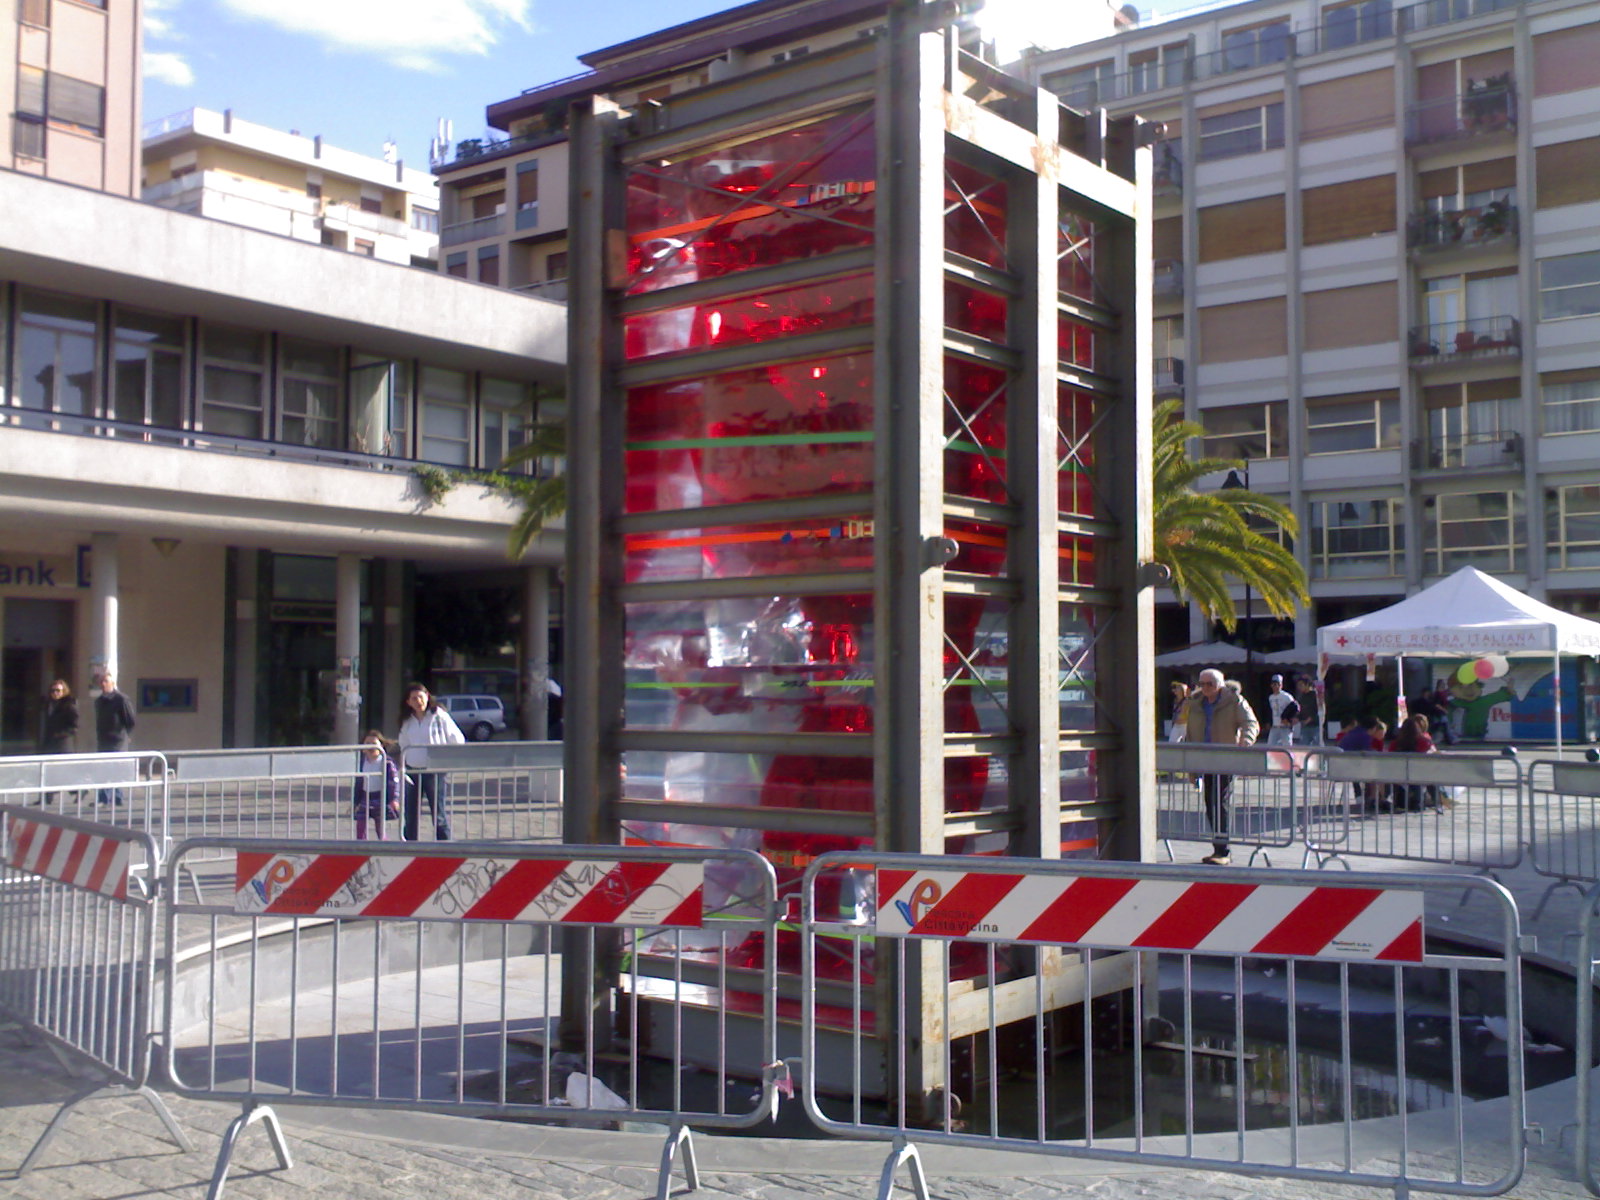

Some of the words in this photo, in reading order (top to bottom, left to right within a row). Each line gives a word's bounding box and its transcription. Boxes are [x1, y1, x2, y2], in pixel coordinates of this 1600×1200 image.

[1354, 634, 1402, 644] CROCE
[1411, 634, 1460, 643] ROSSA
[1468, 633, 1537, 642] ITALIANA
